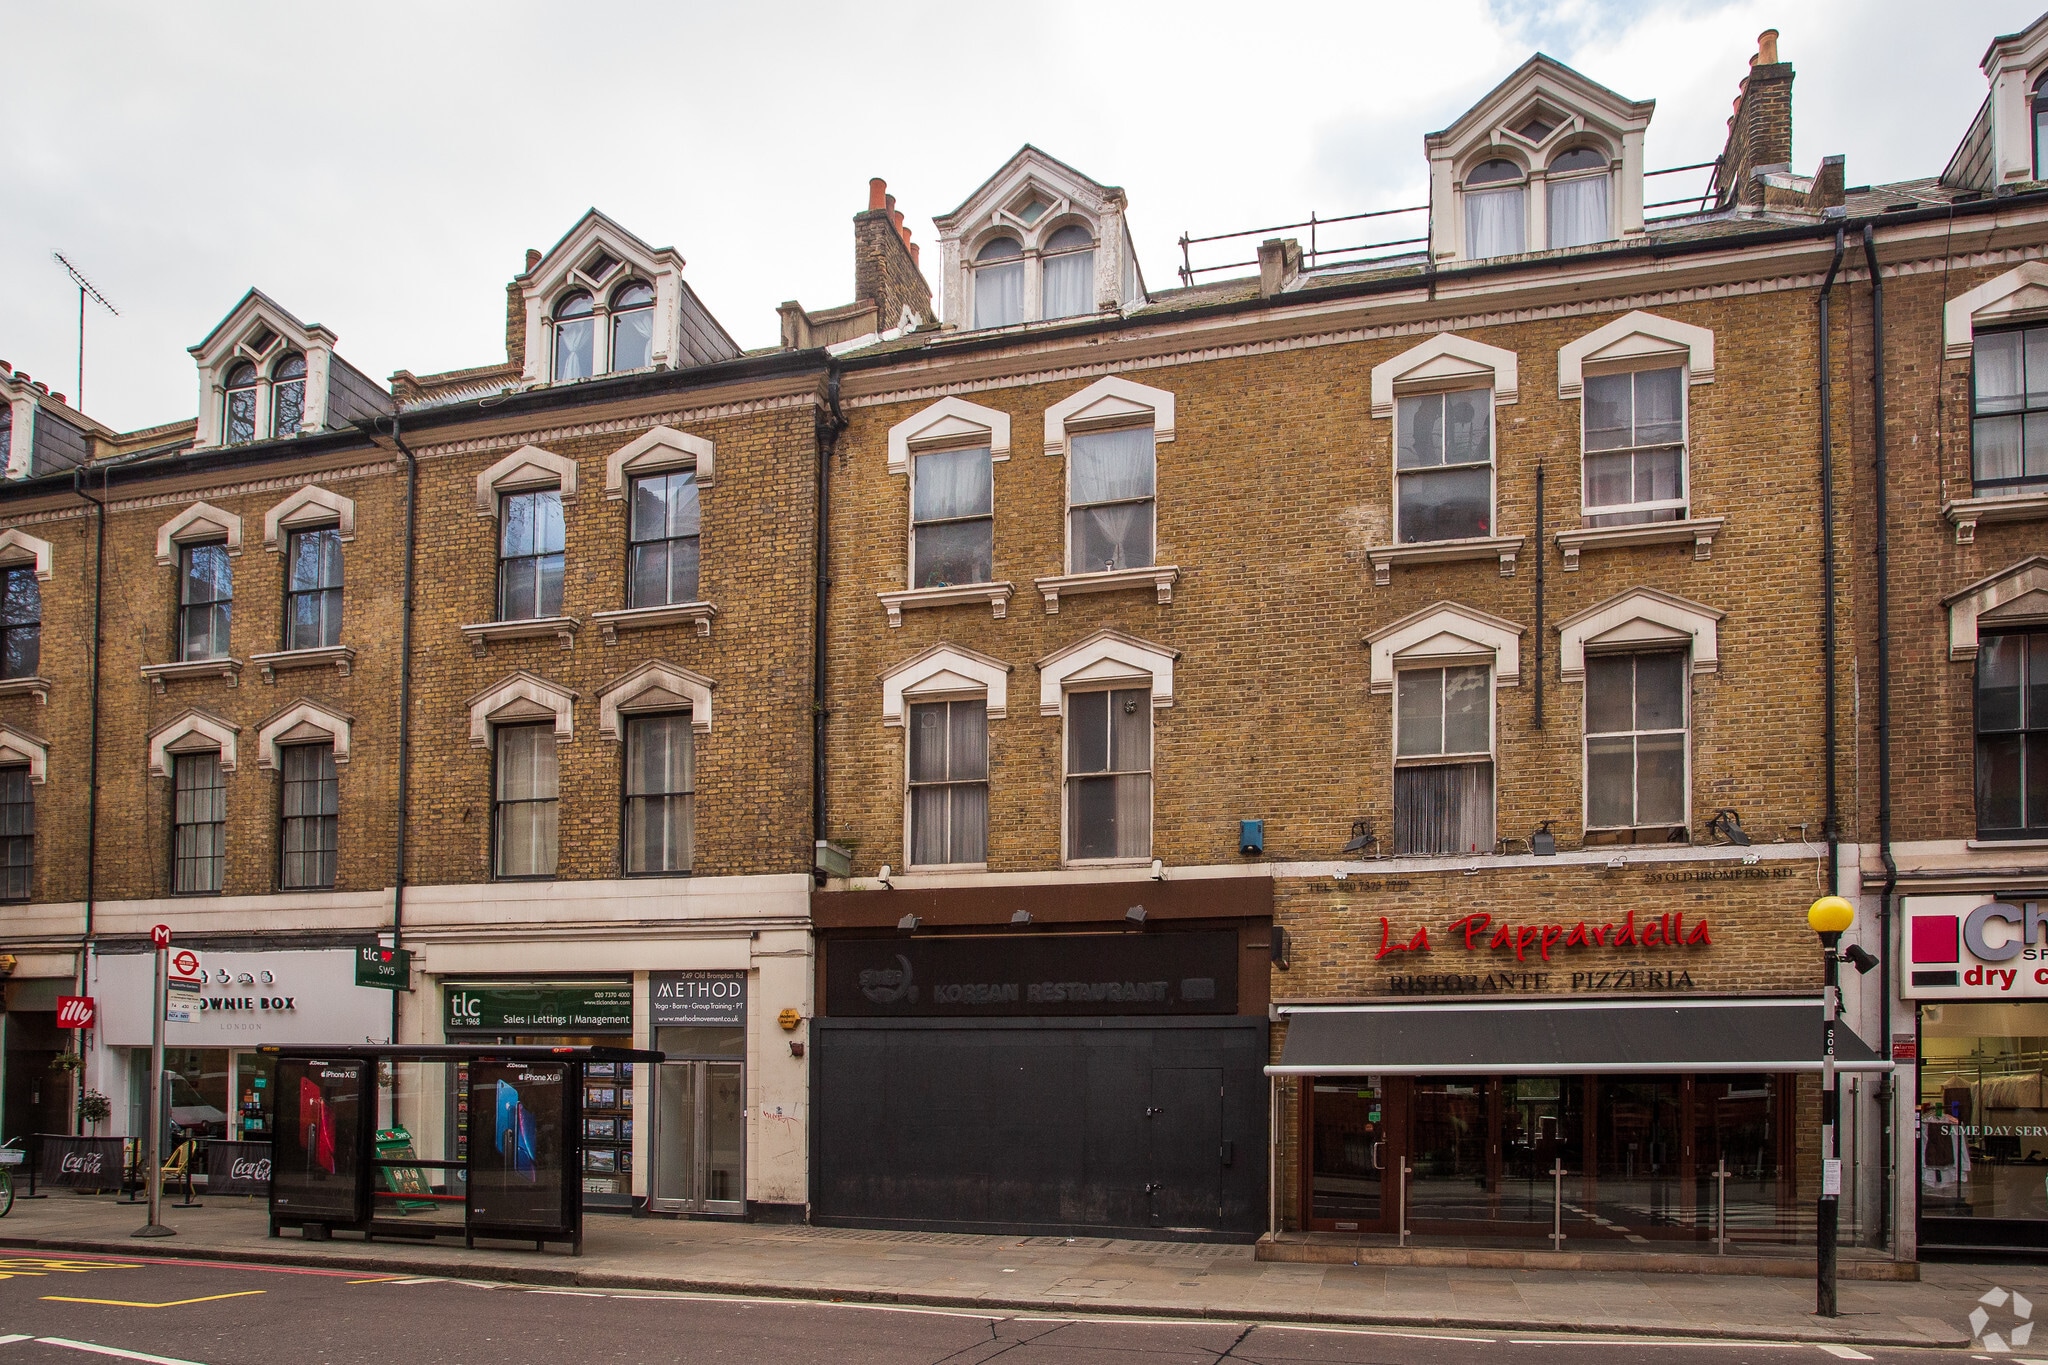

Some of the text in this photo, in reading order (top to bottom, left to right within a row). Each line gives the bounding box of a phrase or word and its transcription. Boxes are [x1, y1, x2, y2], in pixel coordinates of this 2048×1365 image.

[1665, 872, 1693, 883] OLD
[1695, 868, 1769, 881] BROMPTON
[1773, 868, 1793, 878] RD
[1338, 881, 1356, 892] 020
[154, 927, 170, 943] M
[1374, 908, 1713, 962] La Pappardella
[362, 947, 379, 961] tlc
[378, 965, 396, 976] SW5
[706, 972, 734, 980] Brompton
[1389, 970, 1695, 992] RISTORANTE PIZZERIA
[1964, 965, 2017, 991] dry
[657, 982, 741, 998] METHOD
[933, 984, 1019, 1003] KOREAN
[1026, 981, 1168, 1003] RESTAURANT
[200, 996, 296, 1009] OWNIE BOX
[451, 992, 481, 1017] tlc
[654, 1002, 669, 1011] Yoga
[710, 1003, 733, 1011] Training
[60, 1000, 93, 1026] illy
[658, 1014, 739, 1023] www.methodmovement.co.uk
[451, 1017, 480, 1026] Est. 1968
[503, 1014, 630, 1026] Sales Lettings Management
[326, 1070, 344, 1078] iPhone
[524, 1073, 547, 1081] iPhone
[1941, 1125, 1980, 1136] SAME
[1984, 1125, 2012, 1136] DAY
